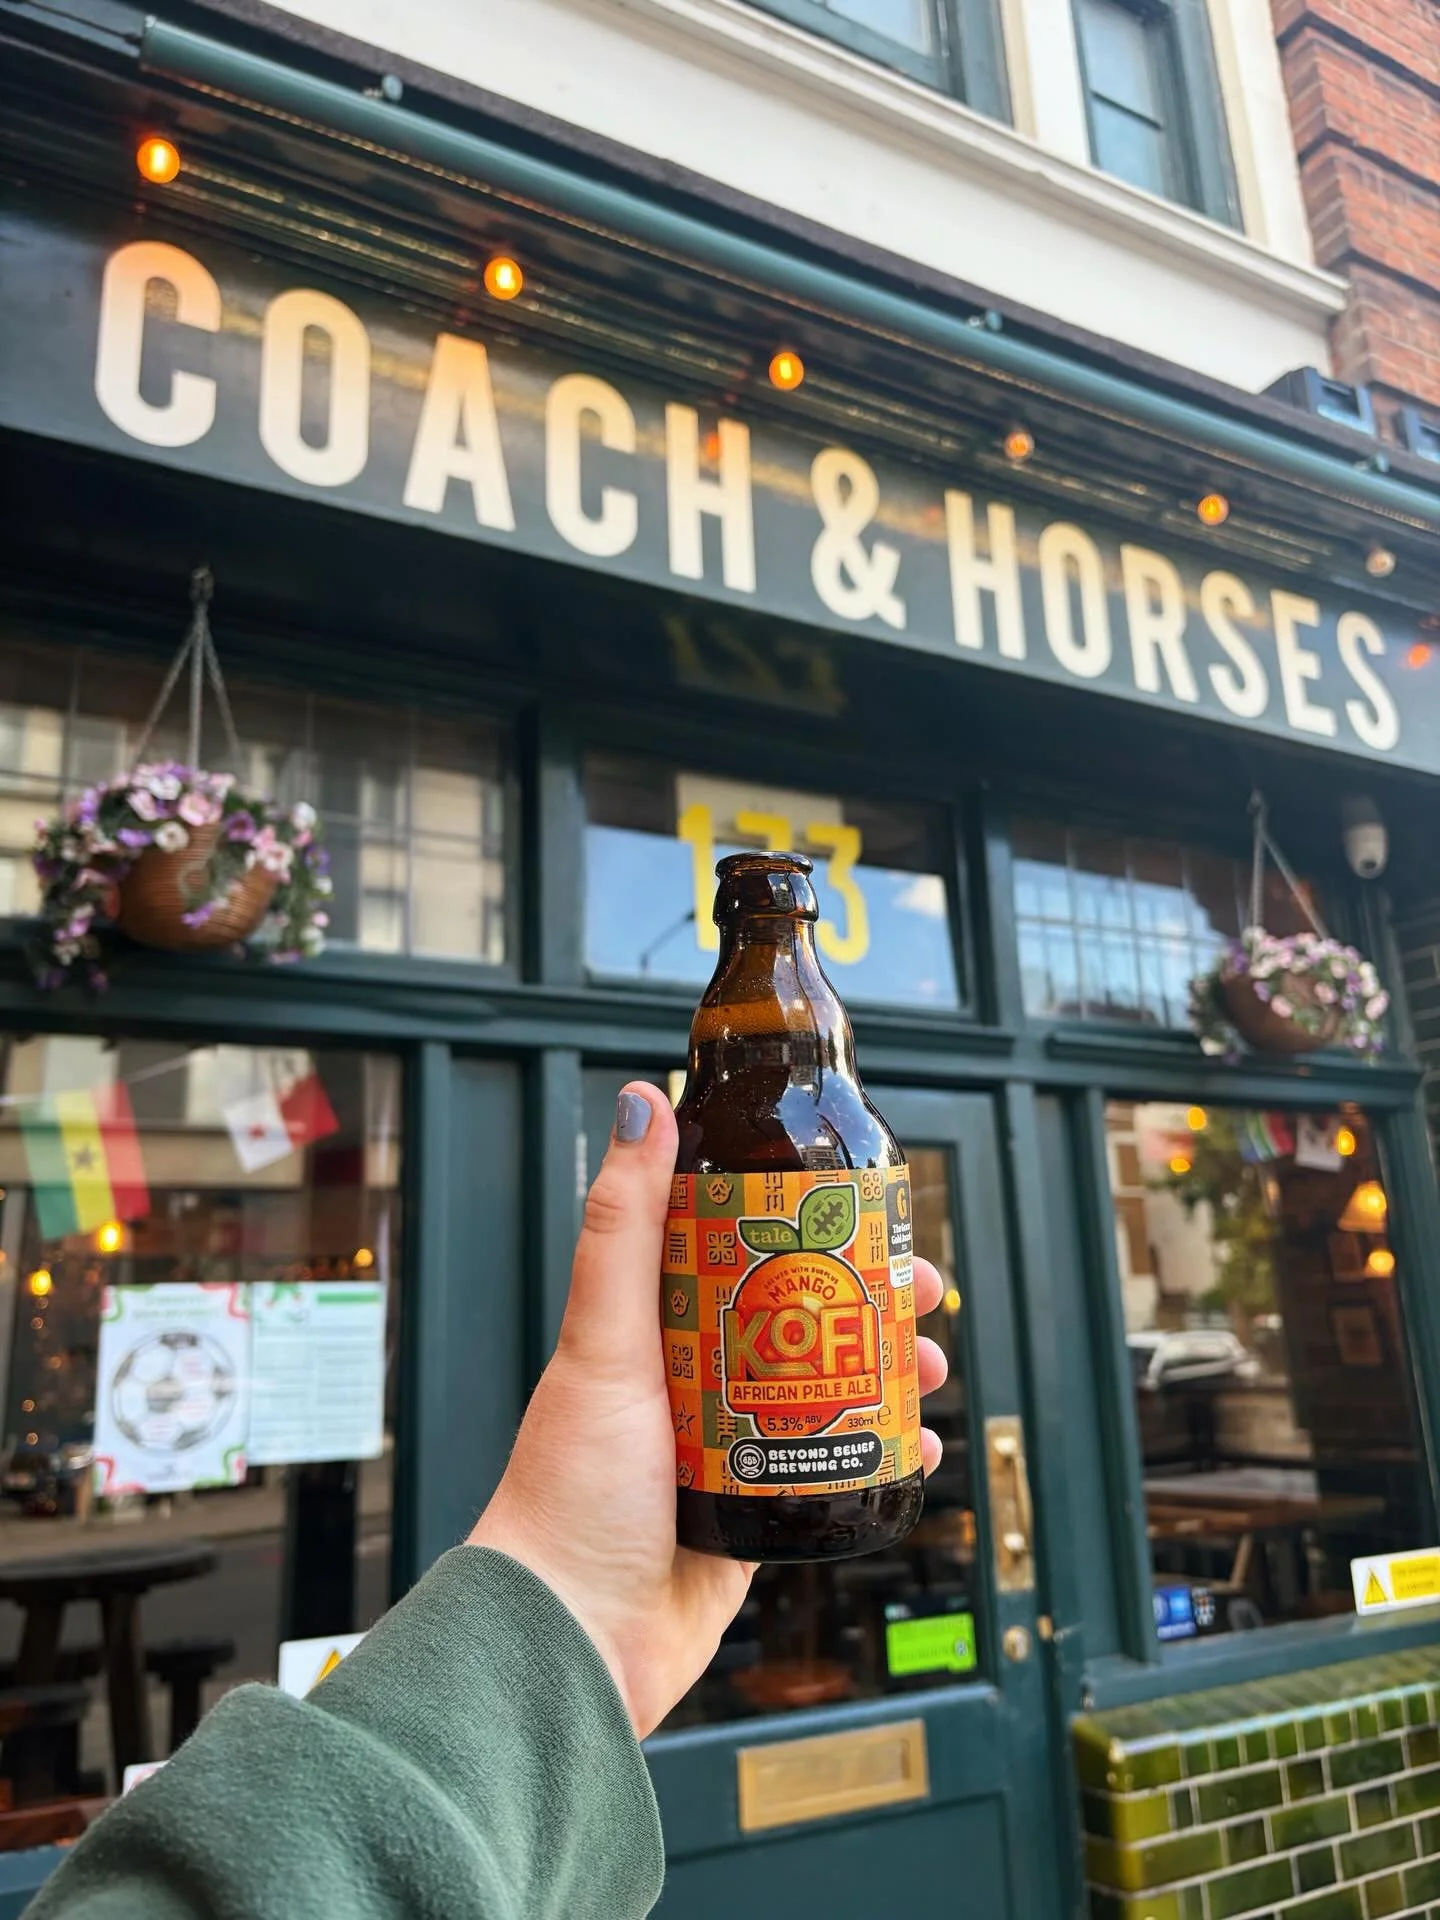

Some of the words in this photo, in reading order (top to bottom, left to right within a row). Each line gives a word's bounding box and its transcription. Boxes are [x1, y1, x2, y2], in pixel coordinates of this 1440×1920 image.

[95, 240, 756, 594] COACH
[811, 447, 906, 629] &
[945, 489, 1400, 751] HORSES
[751, 1228, 792, 1243] tale
[768, 1275, 836, 1304] MANGO
[725, 1304, 874, 1377] KOFI
[733, 1385, 798, 1401] AFRICAN
[803, 1382, 842, 1399] PALE
[847, 1379, 874, 1395] ALE
[767, 1417, 803, 1431] 5.3%
[805, 1416, 822, 1424] ABV
[848, 1416, 874, 1428] 330ml
[768, 1447, 828, 1461] BEYOND
[833, 1441, 875, 1457] BELIEF
[769, 1460, 838, 1474] BREWING
[841, 1457, 863, 1469] CO.
